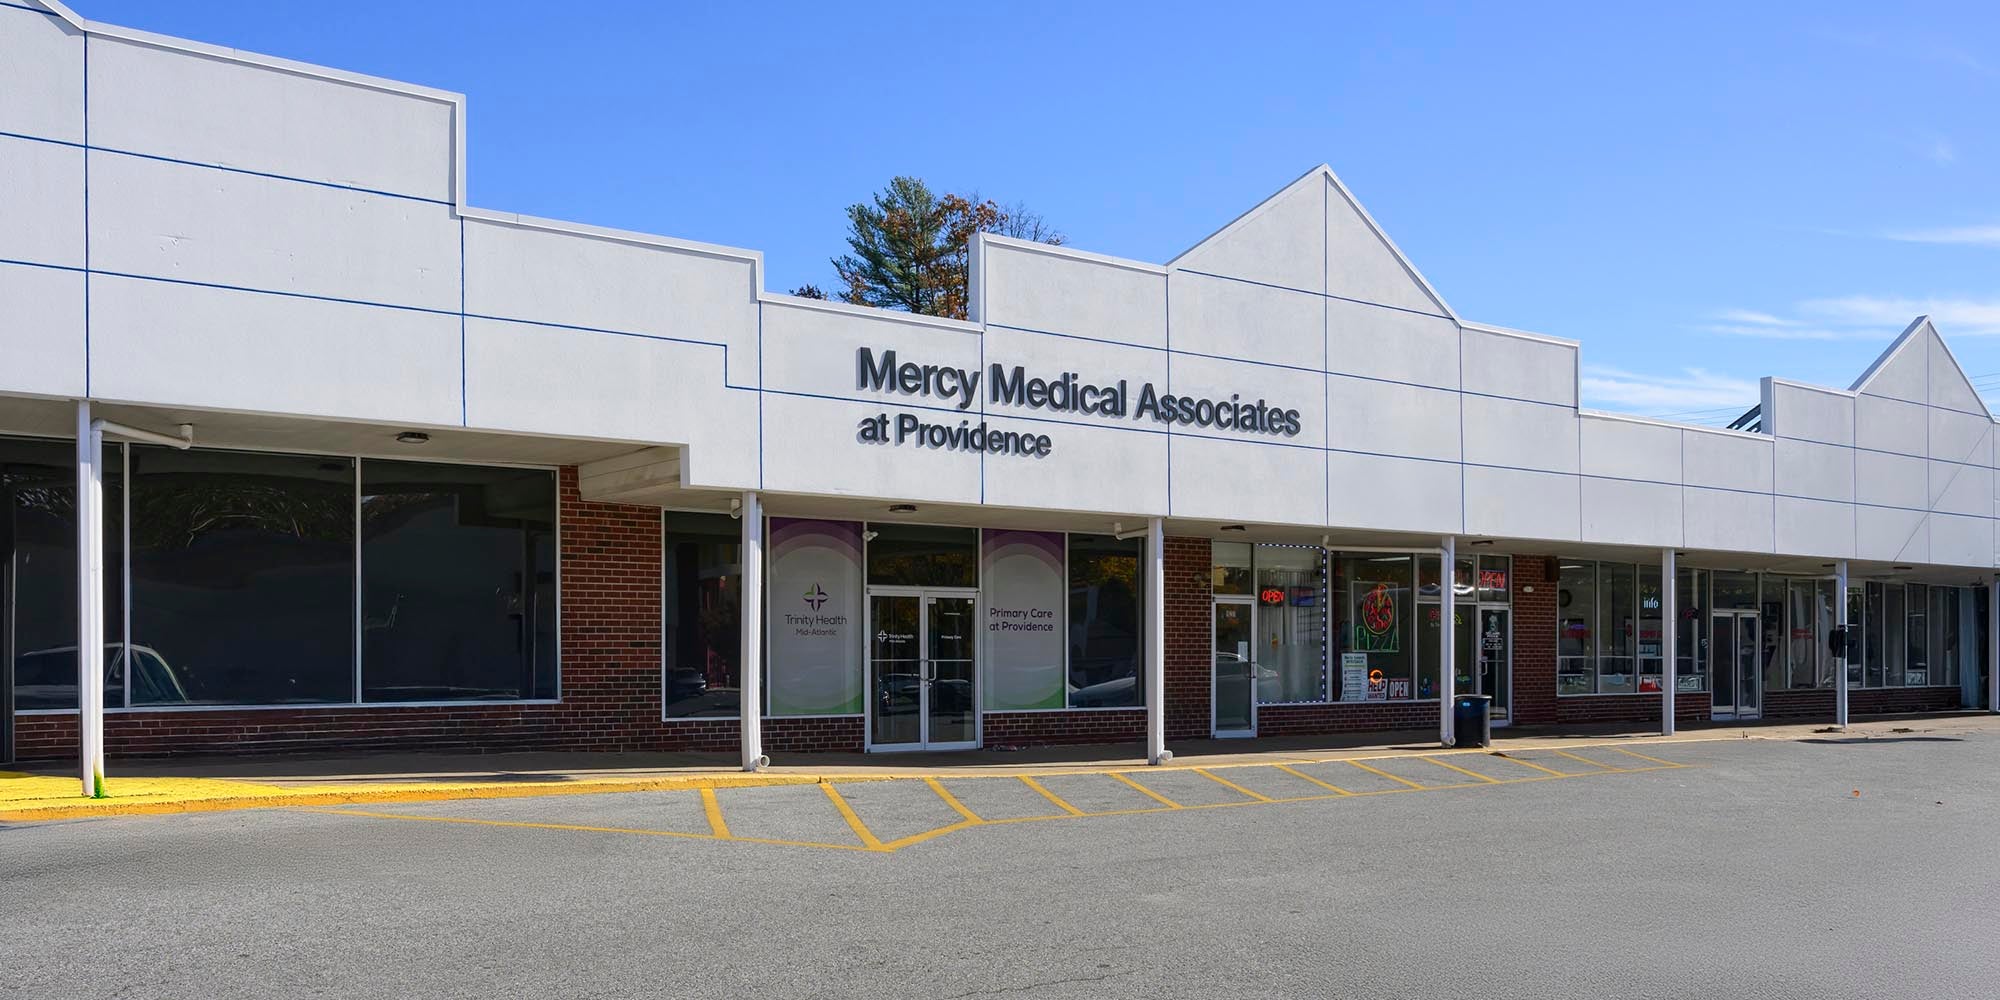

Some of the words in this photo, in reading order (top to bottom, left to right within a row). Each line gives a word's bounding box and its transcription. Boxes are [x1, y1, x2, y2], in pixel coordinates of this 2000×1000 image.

[857, 346, 980, 411] Mercy
[989, 362, 1127, 417] Medical
[1134, 382, 1301, 437] Associates
[857, 413, 890, 444] at
[895, 412, 1052, 459] Providence
[1262, 591, 1284, 602] OPEN
[990, 607, 1028, 620] Primary
[1030, 608, 1053, 618] Care
[785, 614, 814, 628] Trinity
[816, 614, 847, 625] Health
[989, 622, 1000, 631] at
[1001, 621, 1053, 631] Providence
[1368, 680, 1386, 692] HELP
[1390, 681, 1409, 697] OPEN
